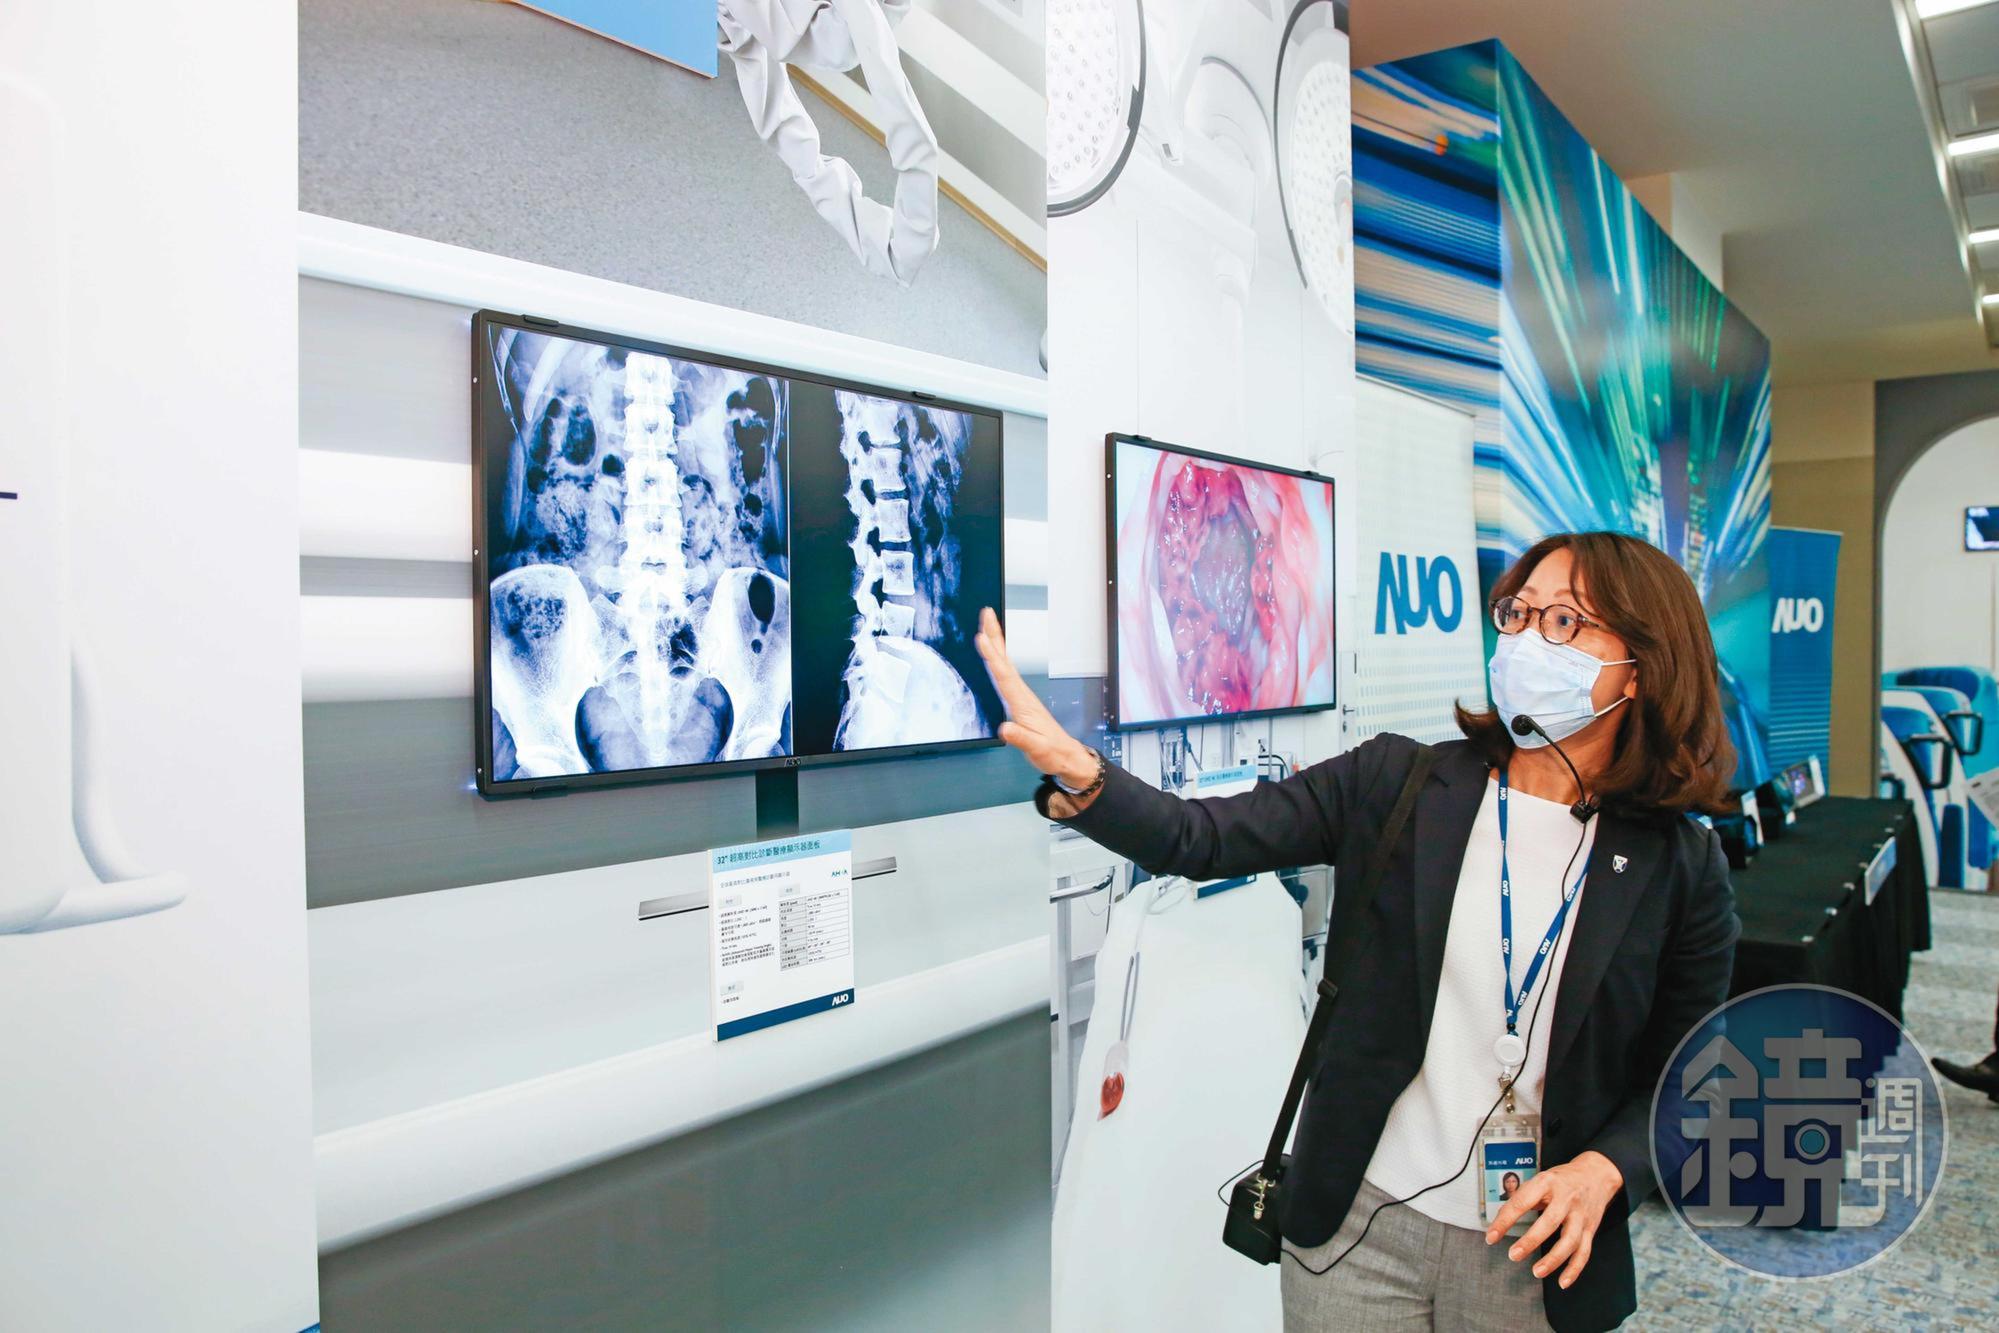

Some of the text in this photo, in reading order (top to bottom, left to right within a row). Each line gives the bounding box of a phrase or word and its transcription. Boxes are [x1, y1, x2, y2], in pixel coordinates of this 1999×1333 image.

[1375, 552, 1463, 634] AUO
[1771, 597, 1824, 633] AUO
[1540, 938, 1551, 955] AUO
[832, 993, 849, 1006] AUO
[1515, 1157, 1533, 1165] AUO
